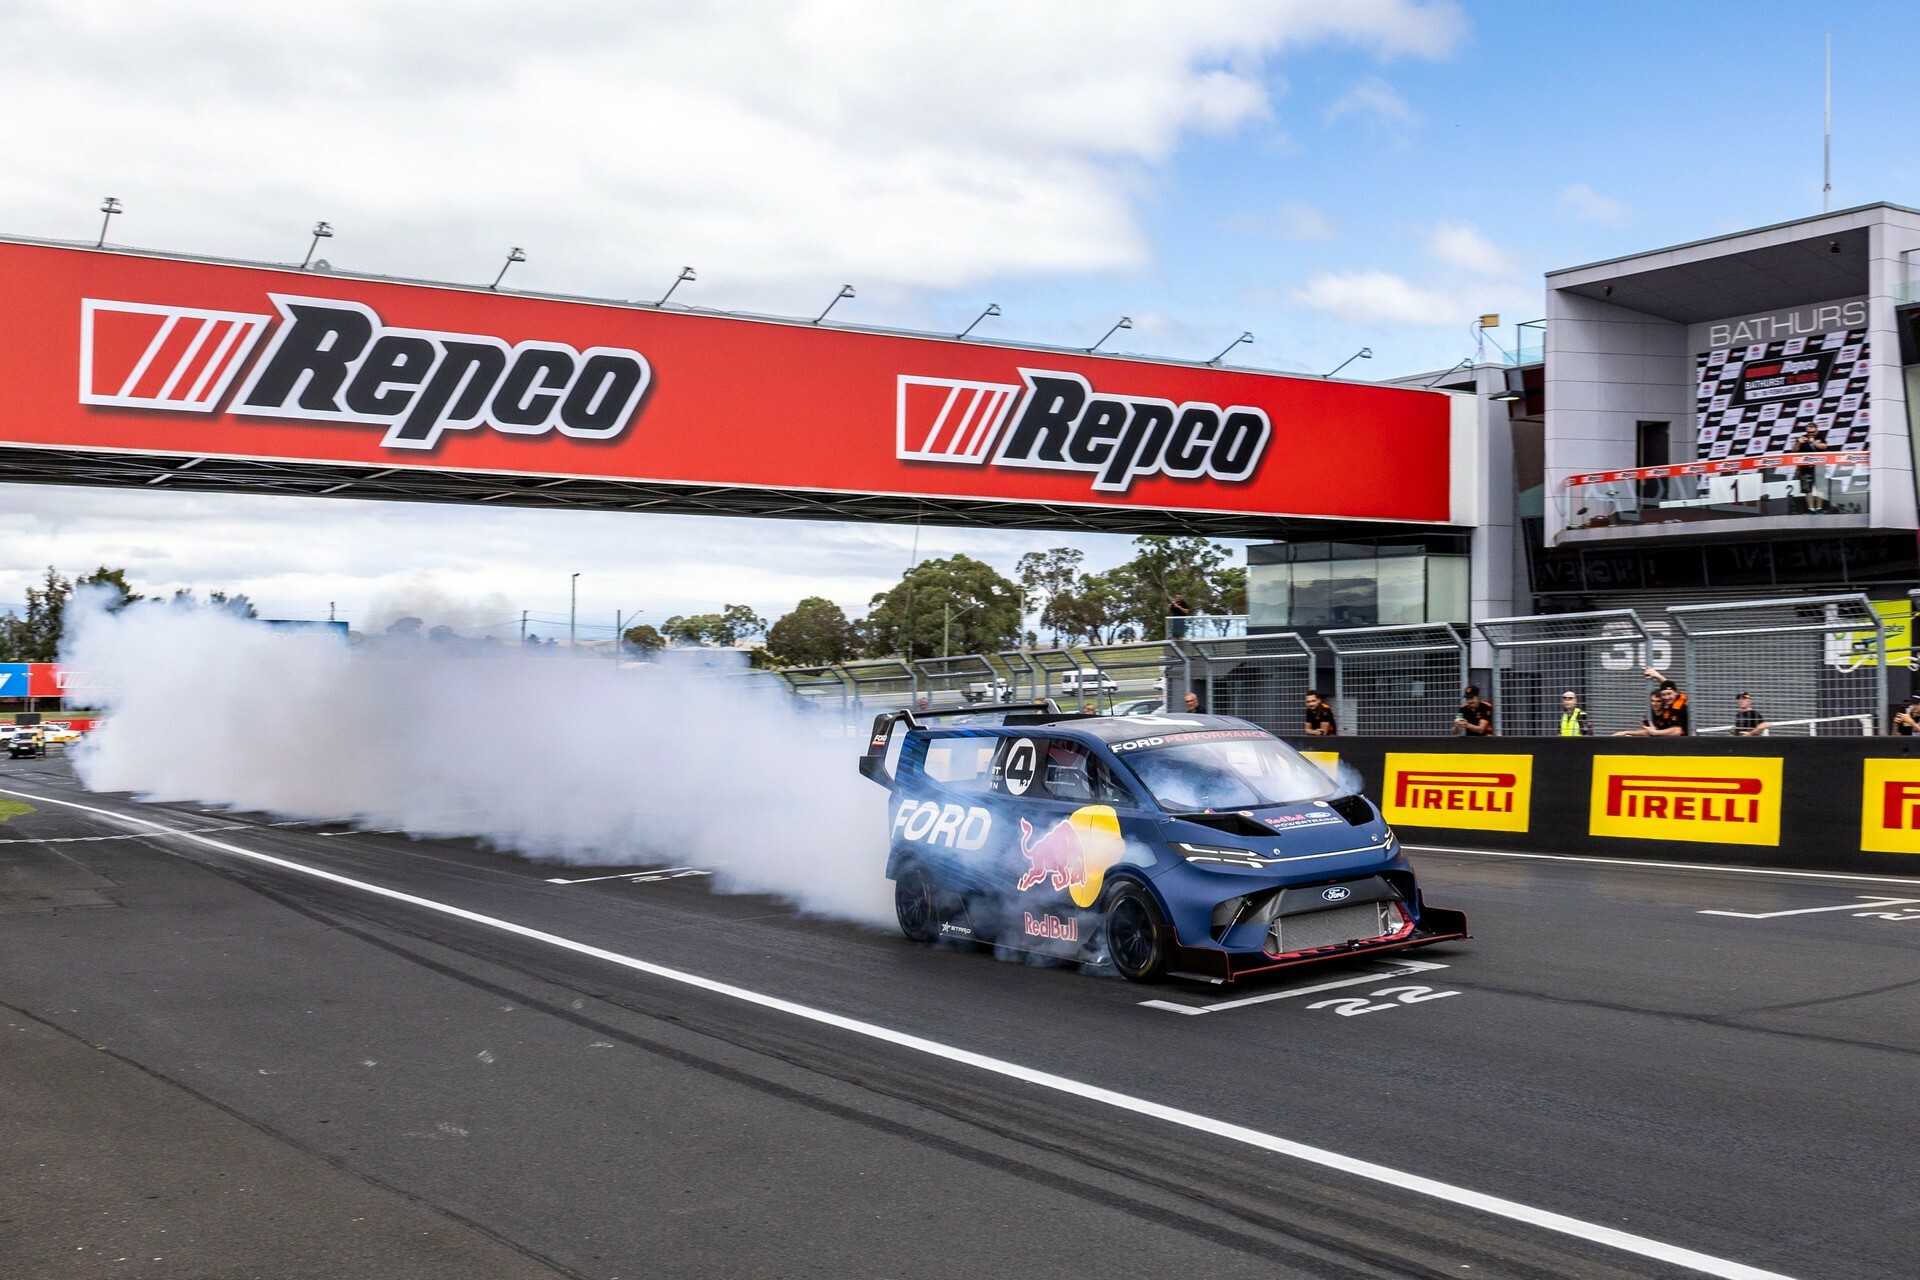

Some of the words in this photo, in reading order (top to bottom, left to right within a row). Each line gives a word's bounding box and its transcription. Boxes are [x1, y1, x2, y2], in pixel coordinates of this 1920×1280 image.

[1710, 300, 1870, 347] BATHURS
[226, 293, 651, 449] Repco
[990, 367, 1271, 491] Repco
[1729, 479, 1739, 502] 1
[1785, 484, 1794, 497] 2
[1110, 737, 1164, 754] FORD
[1164, 730, 1269, 744] PERFORMANCE
[1395, 770, 1517, 813] PIRELLI
[1606, 774, 1763, 823] PIRELLI
[891, 799, 992, 851] FORD
[1274, 816, 1339, 829] POWERTRAINS
[1305, 985, 1463, 1017] 22
